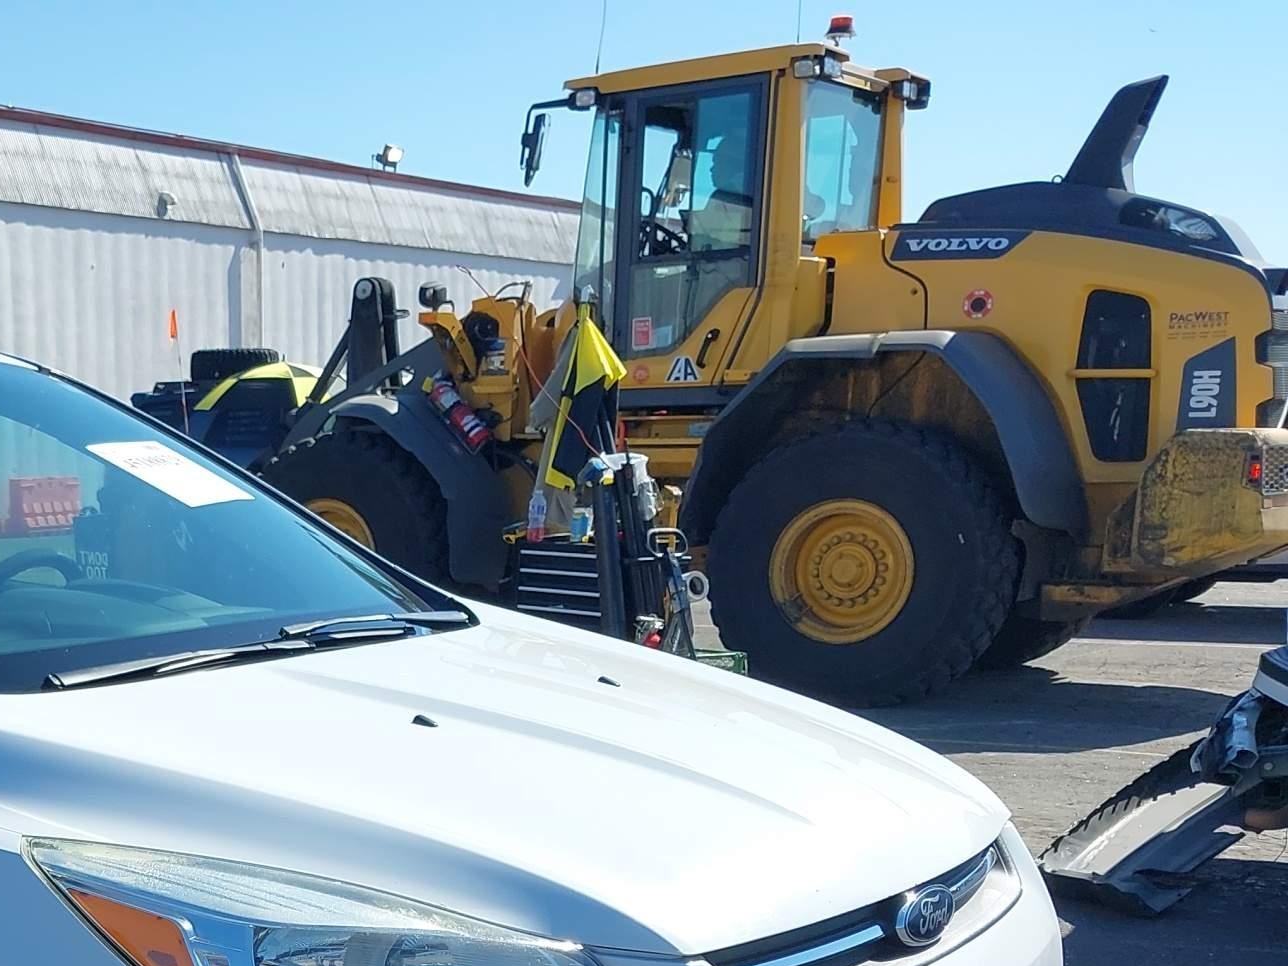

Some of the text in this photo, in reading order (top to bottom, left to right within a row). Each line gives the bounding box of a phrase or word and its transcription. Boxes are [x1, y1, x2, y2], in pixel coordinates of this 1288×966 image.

[906, 237, 1009, 252] VOLVO
[1188, 370, 1222, 418] L90H
[919, 893, 950, 935] Ford
